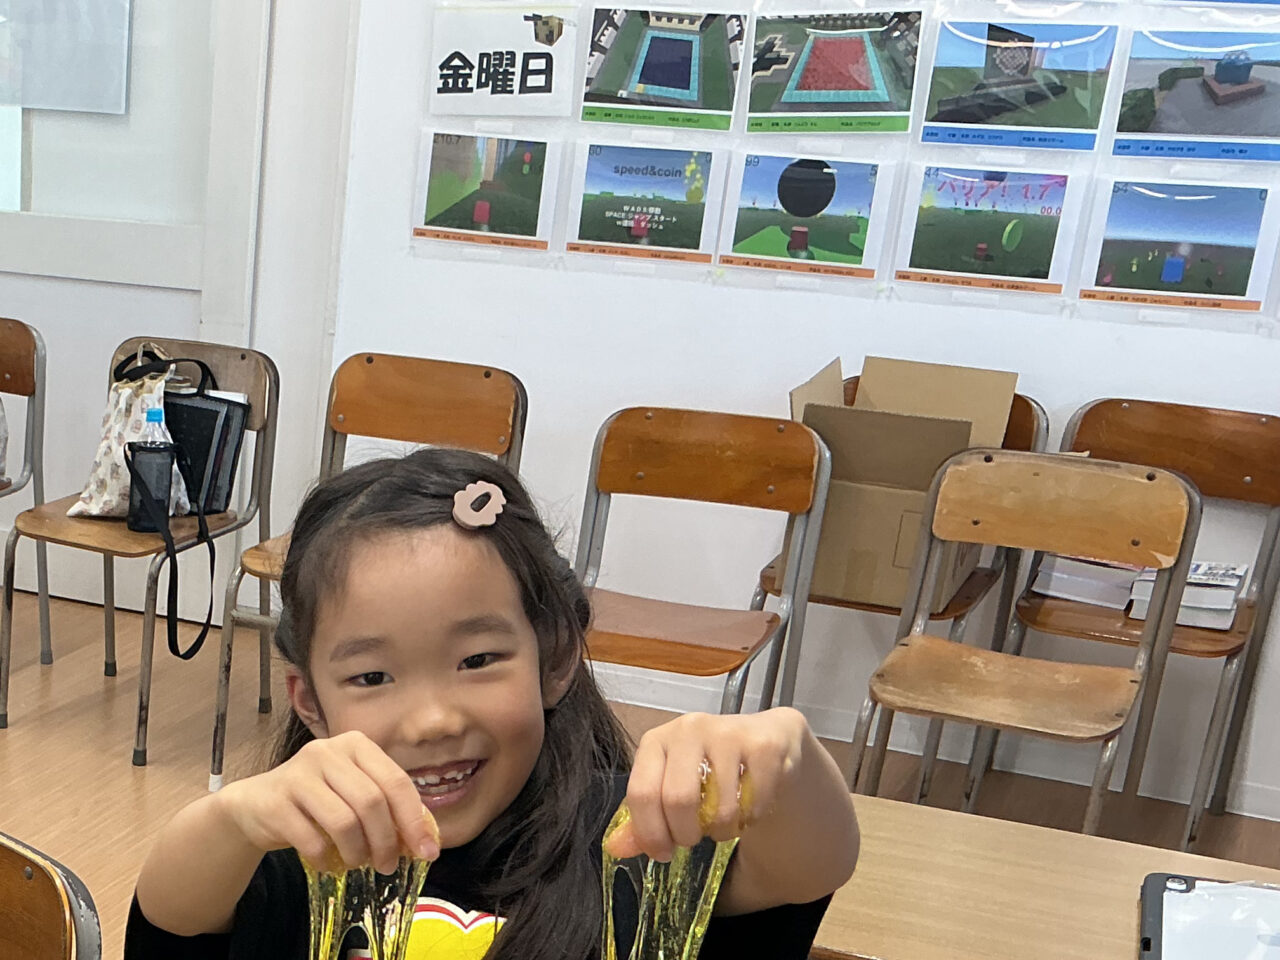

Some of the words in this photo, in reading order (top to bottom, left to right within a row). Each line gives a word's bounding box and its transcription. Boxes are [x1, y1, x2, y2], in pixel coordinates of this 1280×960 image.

[437, 51, 554, 95] 金曜日
[613, 165, 682, 178] speed&coin
